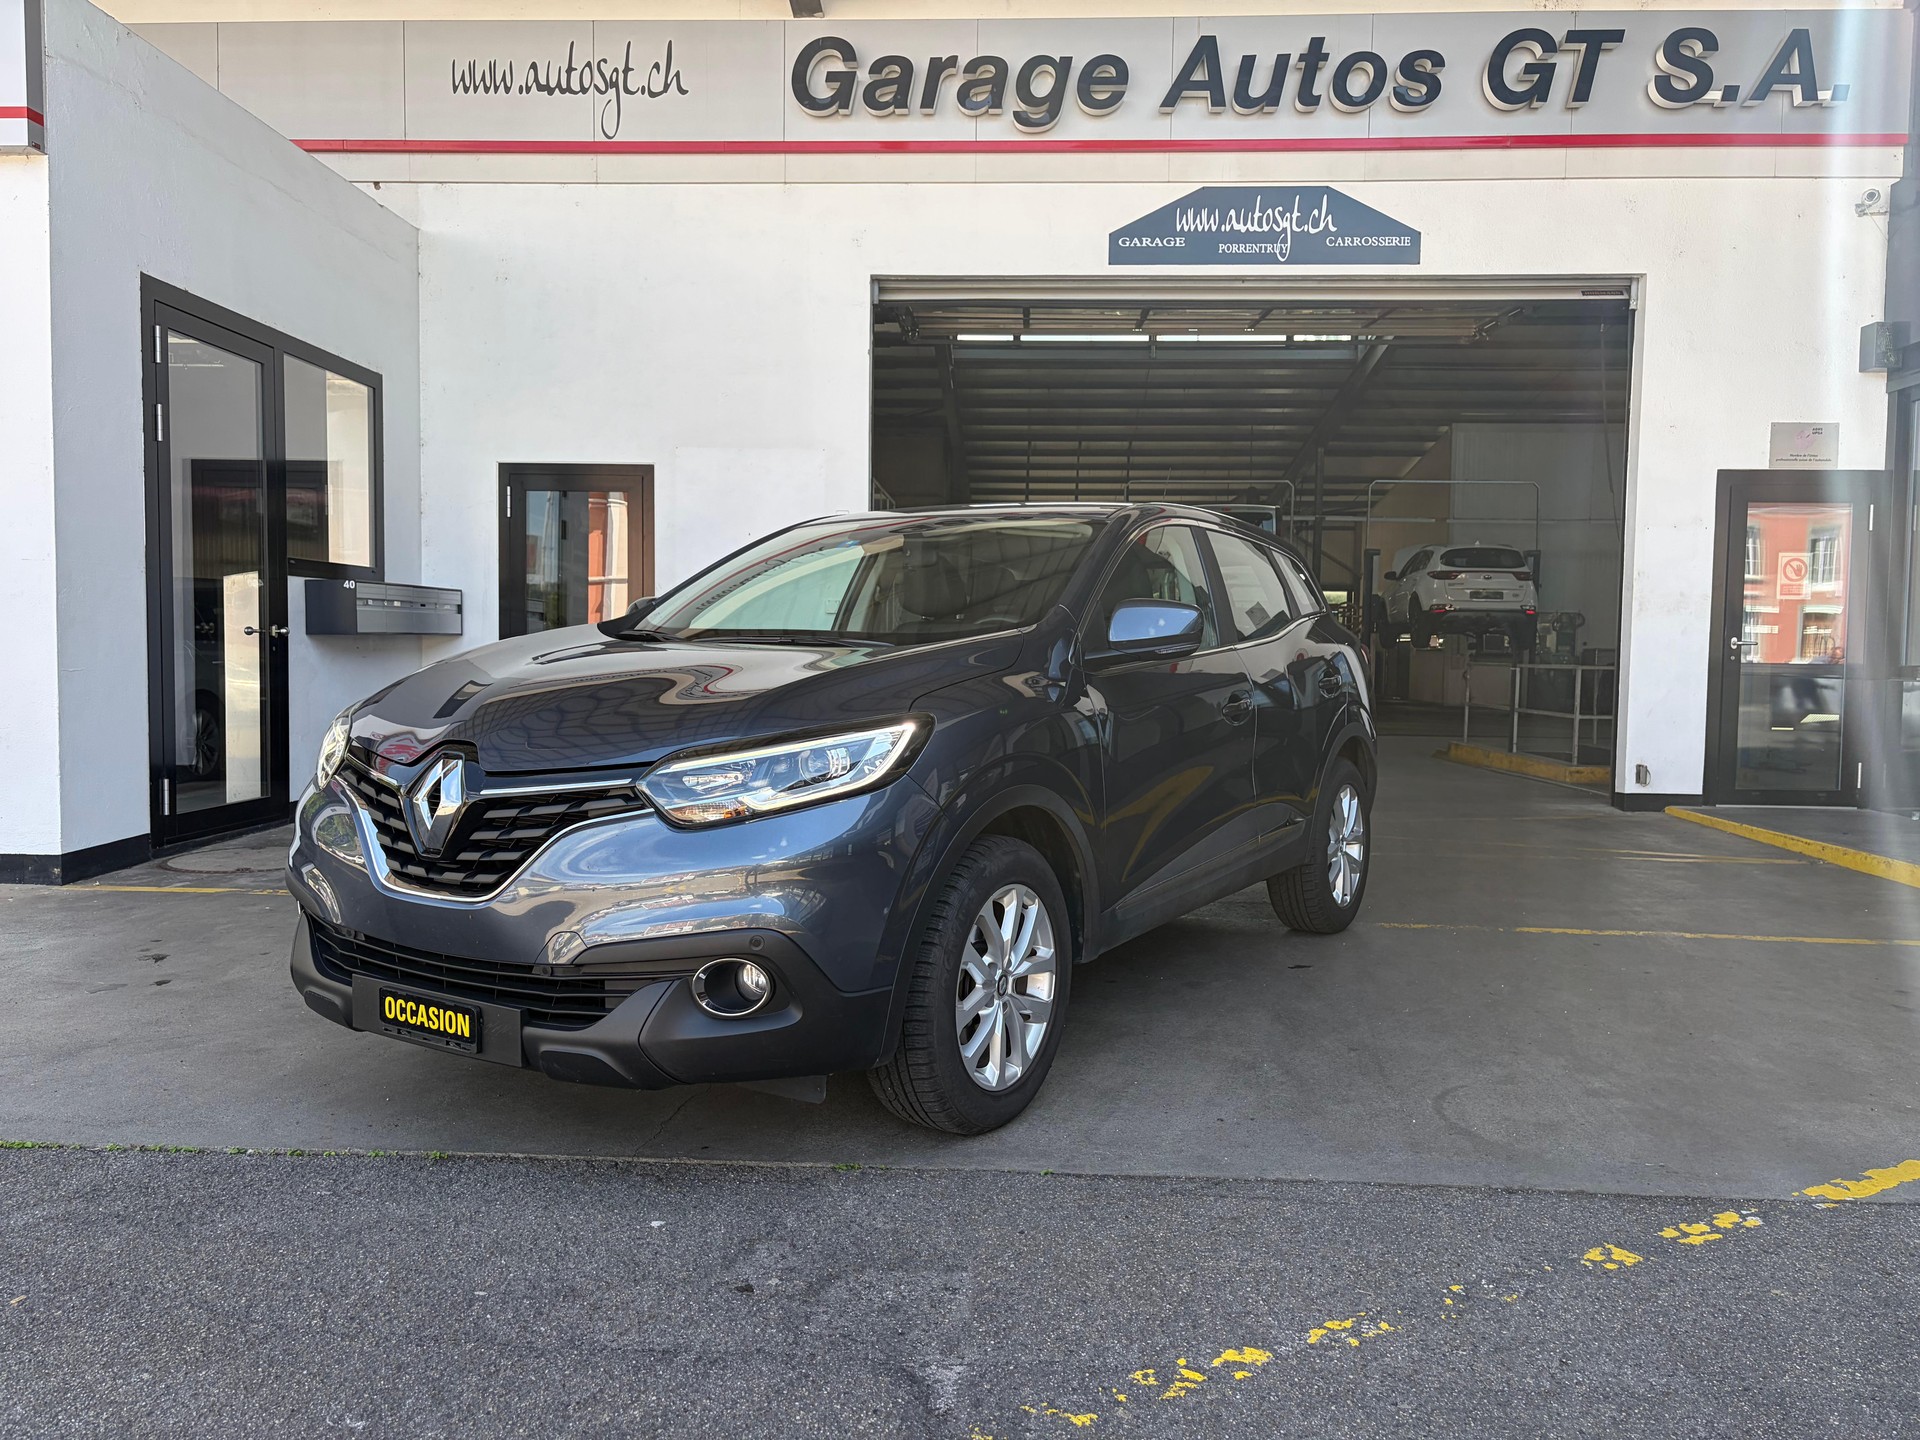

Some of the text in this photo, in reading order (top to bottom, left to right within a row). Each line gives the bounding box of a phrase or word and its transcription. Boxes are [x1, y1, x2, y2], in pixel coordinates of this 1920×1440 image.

[452, 39, 690, 140] www.autosgt.ch
[791, 27, 1851, 132] Garage Autos GT S.A.
[1175, 194, 1338, 262] www.autosgt.ch
[1118, 236, 1186, 247] GARAGE
[1218, 243, 1289, 254] PORRENTRUY
[1325, 236, 1412, 247] CARROSSERIE
[343, 580, 356, 589] 40
[384, 996, 471, 1038] OCCASION
